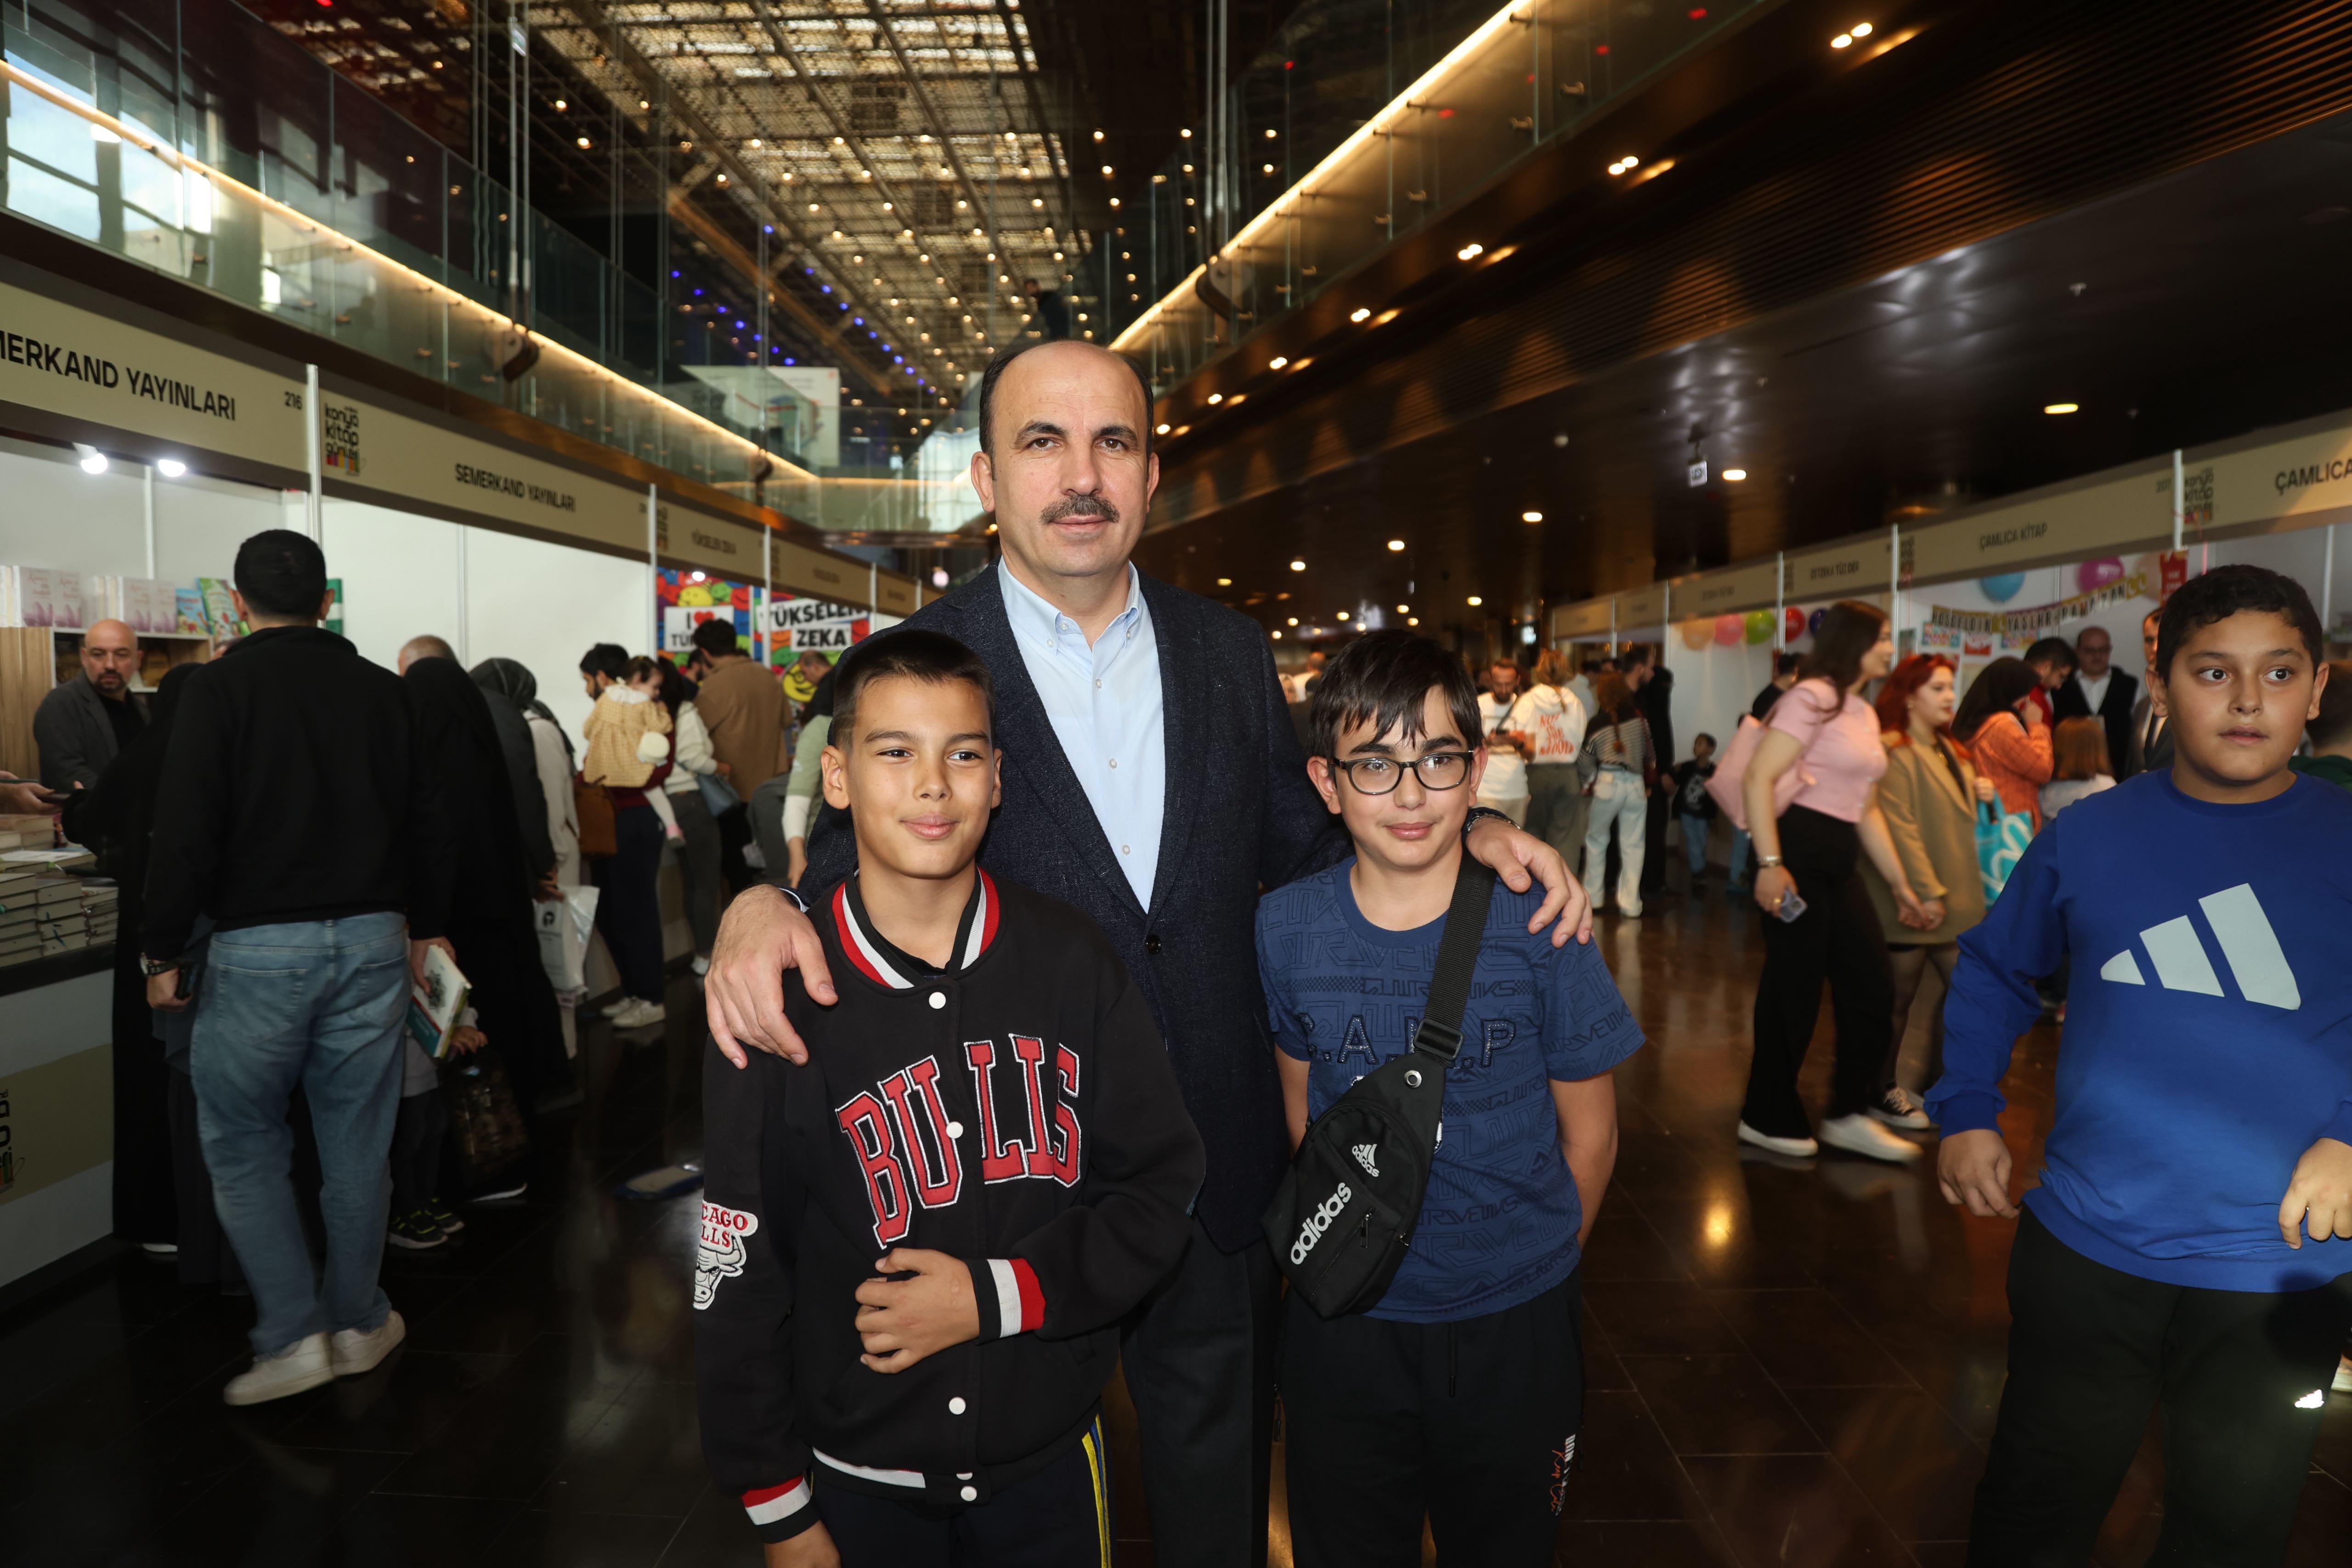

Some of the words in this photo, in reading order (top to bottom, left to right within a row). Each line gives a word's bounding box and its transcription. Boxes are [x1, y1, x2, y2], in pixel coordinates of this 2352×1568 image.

[126, 367, 236, 421] YAYINLARI
[284, 391, 302, 410] 216
[324, 402, 359, 429] konya
[325, 419, 359, 447] kitap
[455, 463, 526, 498] SEMERKAND
[528, 483, 576, 512] YAYINLARI
[2275, 457, 2352, 497] ÇAMLICA
[1980, 529, 2019, 551] ÇAMLICA
[2021, 521, 2047, 540] KİTAP
[760, 601, 863, 627] ÜKSELE
[797, 628, 847, 647] ZEKA
[835, 1033, 1081, 1250] BULLS
[1351, 1145, 1380, 1177] adidas
[1290, 1182, 1351, 1265] adidas
